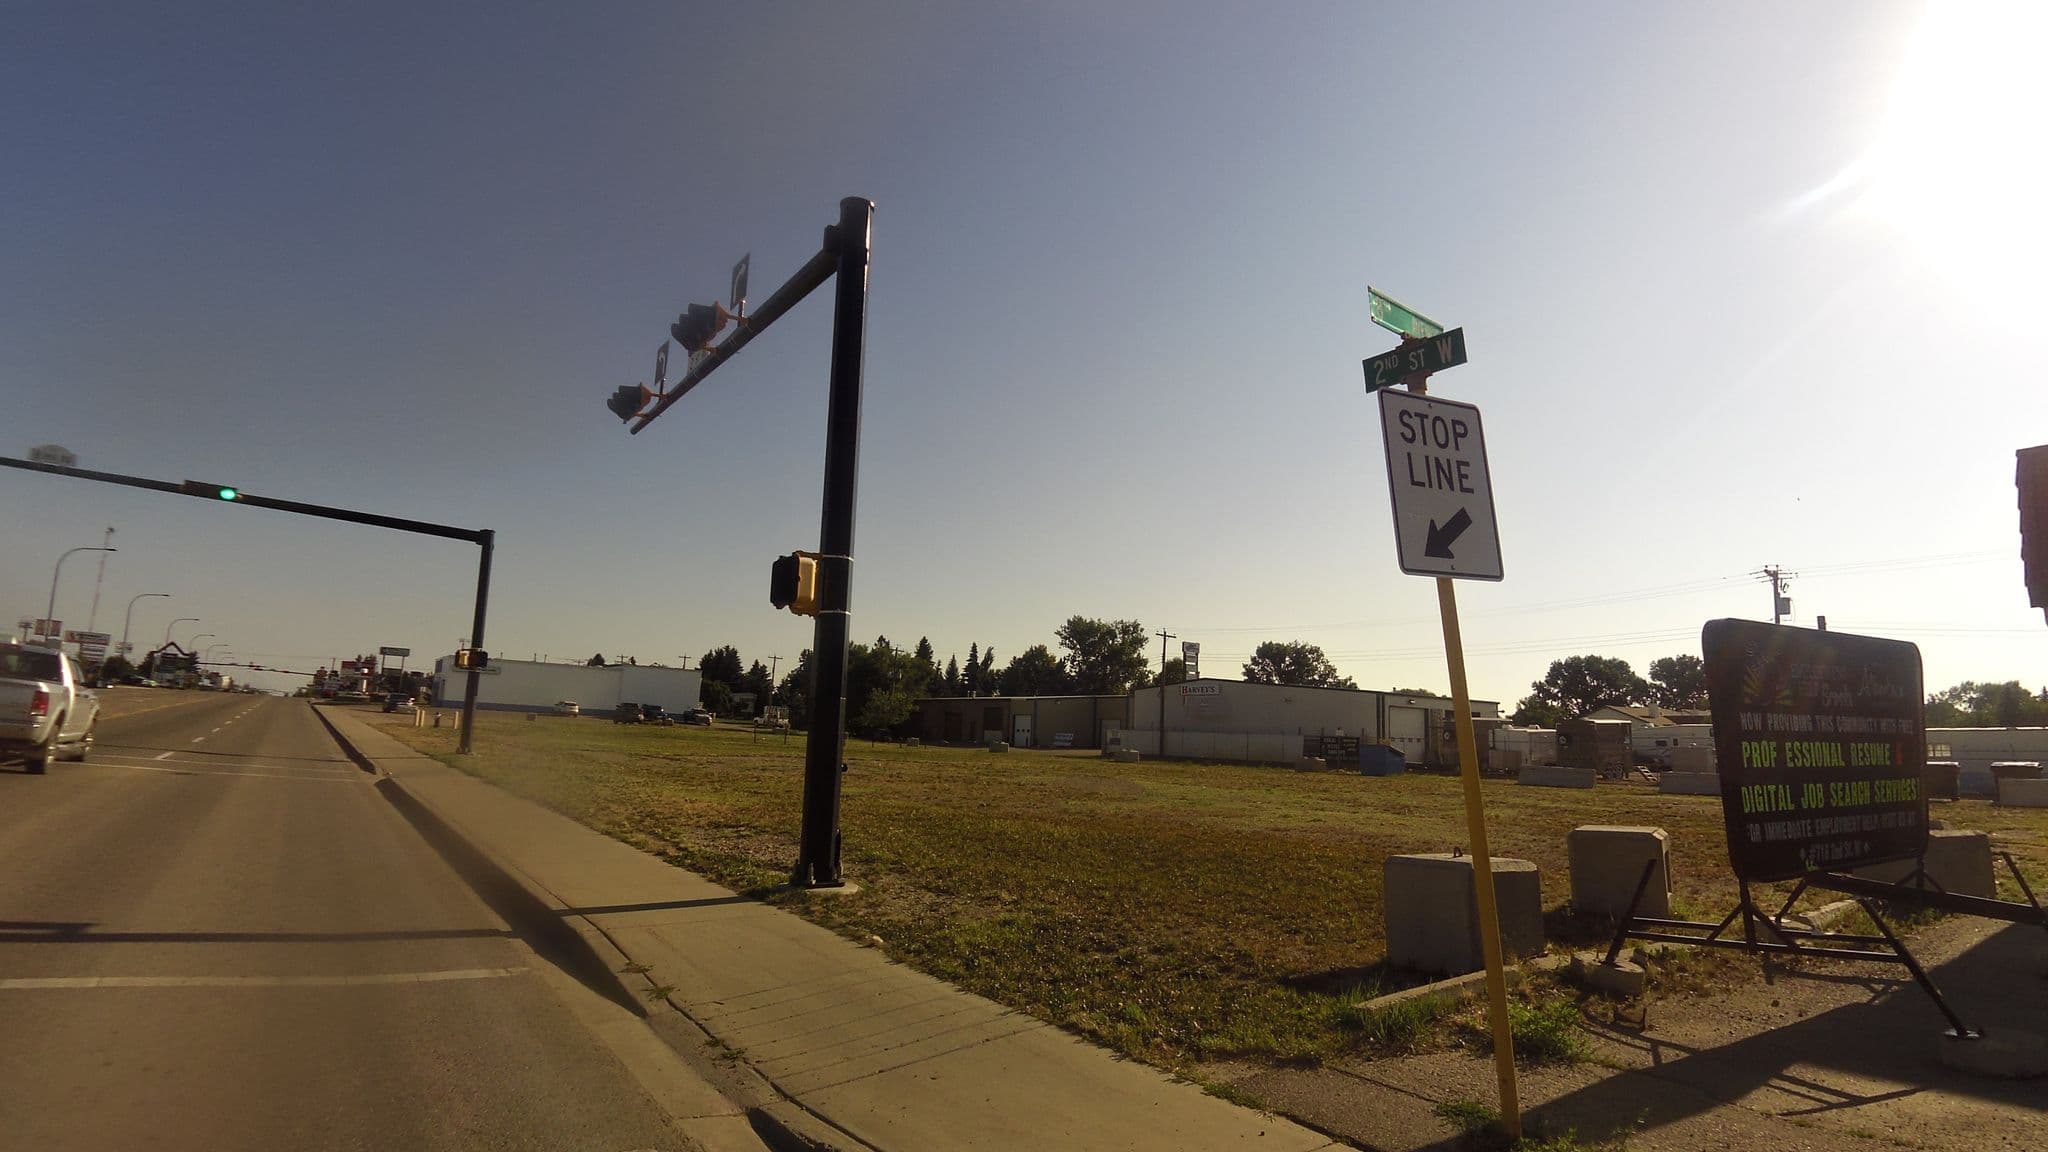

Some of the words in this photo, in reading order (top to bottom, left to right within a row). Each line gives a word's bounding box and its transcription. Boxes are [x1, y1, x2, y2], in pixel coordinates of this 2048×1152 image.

[1374, 354, 1399, 385] 2ND
[1409, 348, 1425, 371] ST
[1436, 335, 1452, 364] W
[1399, 409, 1468, 451] STOP
[1406, 452, 1475, 494] LINE
[1740, 712, 1762, 731] NOW
[1850, 742, 1891, 767] RESUME
[1741, 784, 1795, 813] DIGITAL
[1801, 783, 1825, 809] JOB
[1829, 780, 1870, 808] SEARCH
[1764, 819, 1812, 841] IMMEDIATE
